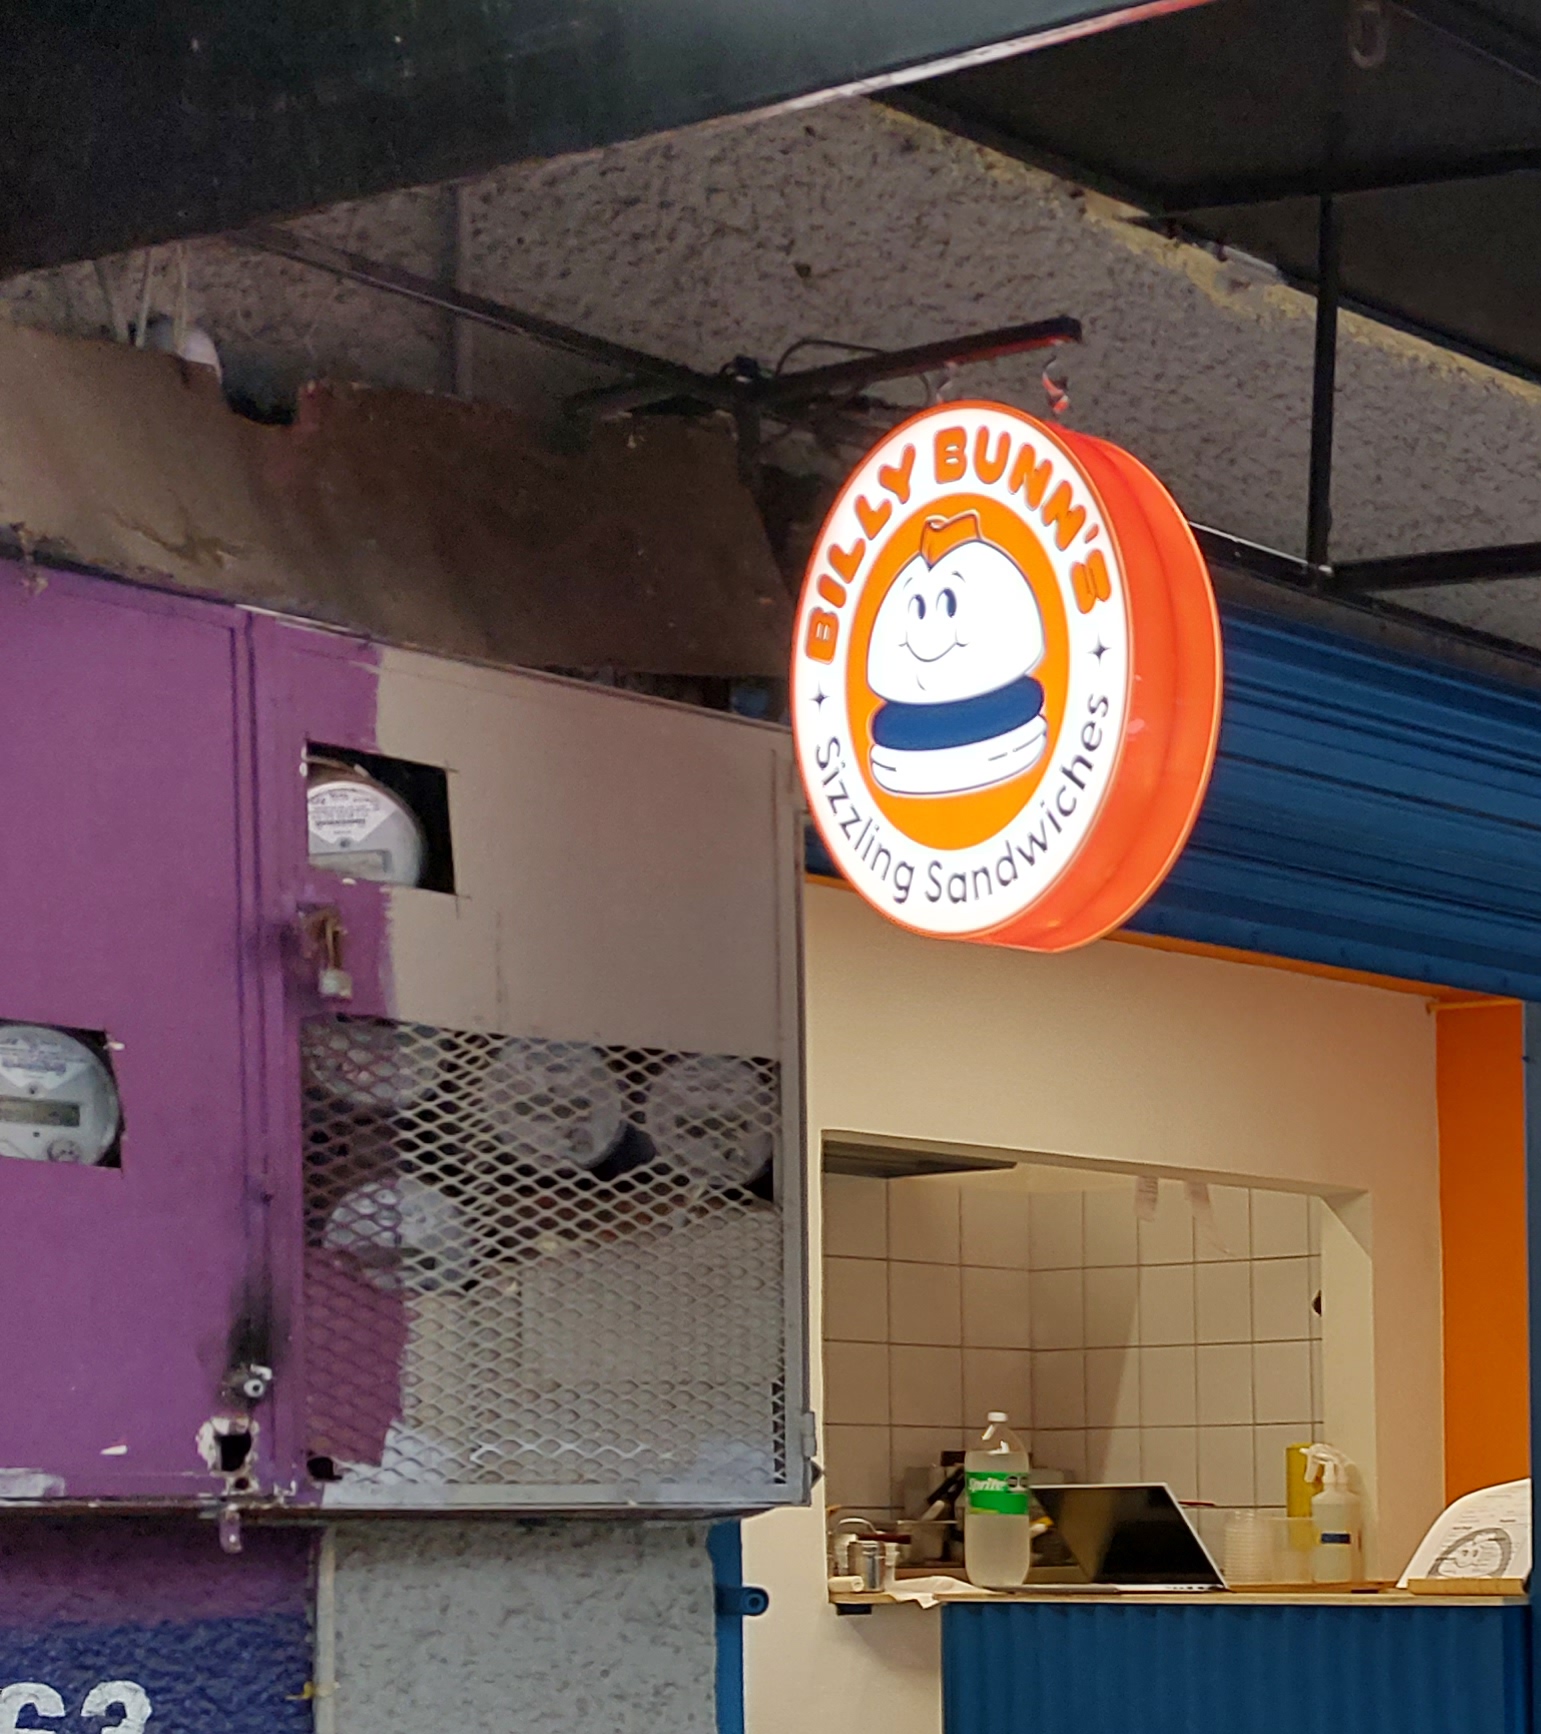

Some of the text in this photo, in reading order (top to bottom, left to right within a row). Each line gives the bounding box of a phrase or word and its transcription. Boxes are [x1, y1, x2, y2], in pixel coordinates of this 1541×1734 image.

[805, 425, 1112, 665] BILLY BUNN'S
[816, 694, 1109, 904] Sizzling Sandwiches
